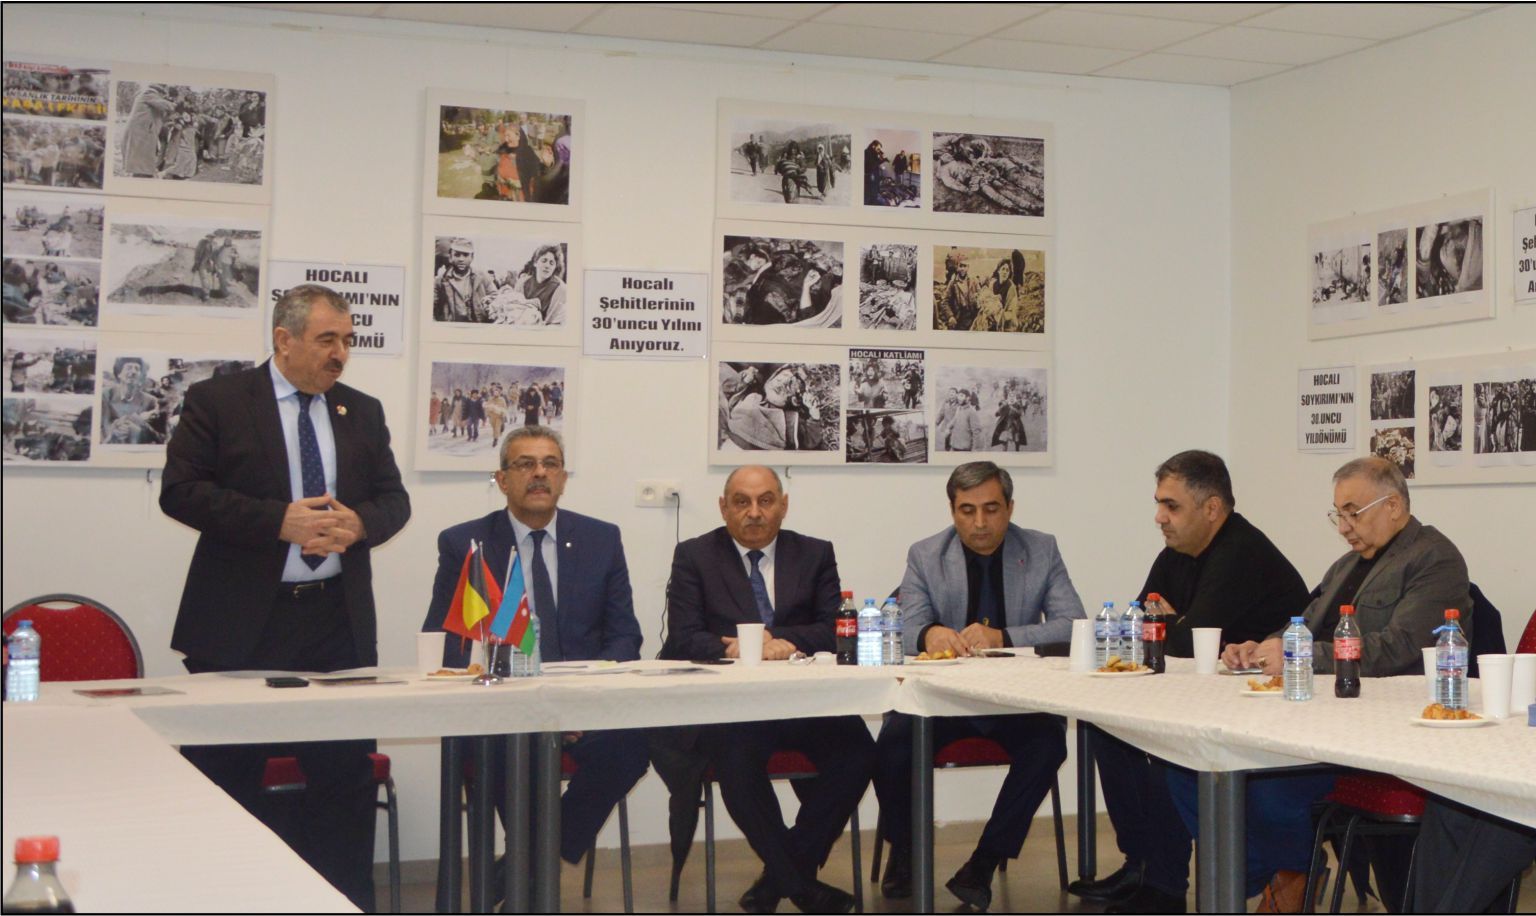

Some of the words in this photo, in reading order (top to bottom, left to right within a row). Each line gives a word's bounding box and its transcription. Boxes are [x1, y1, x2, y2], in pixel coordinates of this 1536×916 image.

[306, 269, 368, 283] HOCALI
[622, 277, 674, 290] Hocalı
[600, 296, 695, 312] Şehitlerinin
[592, 317, 658, 330] 30'uncu
[661, 318, 702, 331] Yılını
[609, 338, 684, 353] Anıyoruz.
[850, 350, 881, 359] HOCALI
[883, 351, 922, 360] KATLİAMI
[1313, 373, 1340, 386] HOCALI
